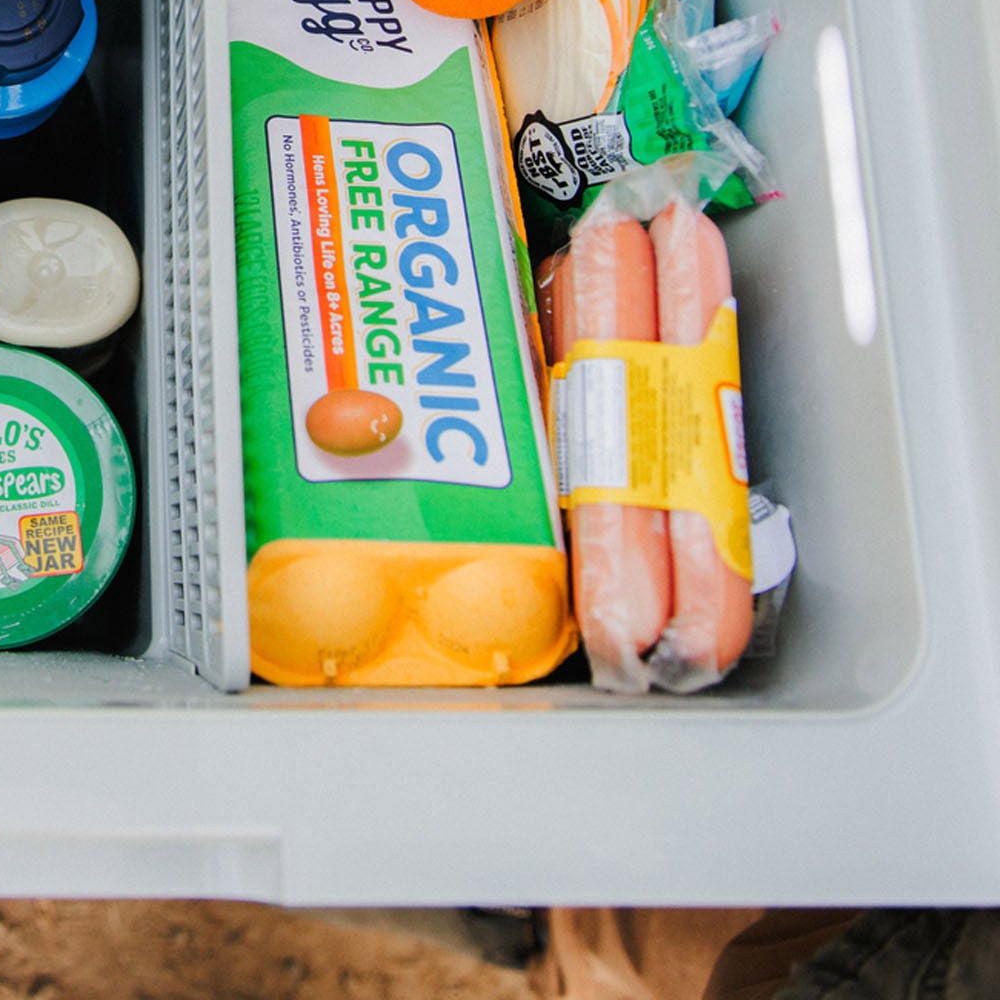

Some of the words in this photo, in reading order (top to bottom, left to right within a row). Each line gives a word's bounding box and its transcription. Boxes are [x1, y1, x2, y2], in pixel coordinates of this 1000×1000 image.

[282, 134, 292, 151] No
[312, 154, 326, 186] Hens
[340, 139, 386, 232] FREE
[316, 188, 331, 238] Loving
[291, 219, 305, 287] Antibiotics
[321, 241, 336, 270] Life
[324, 271, 335, 290] on
[297, 289, 306, 302] or
[326, 292, 341, 311] 8+
[386, 140, 489, 467] ORGANIC
[351, 243, 404, 386] RANGE
[299, 305, 314, 374] Pesticides
[329, 311, 344, 355] Acres
[0, 501, 38, 513] CLASSIC
[40, 499, 61, 510] DILL
[25, 524, 75, 539] RECIPE
[30, 514, 67, 528] SAME
[25, 535, 77, 556] NEW
[33, 552, 76, 573] JAR
